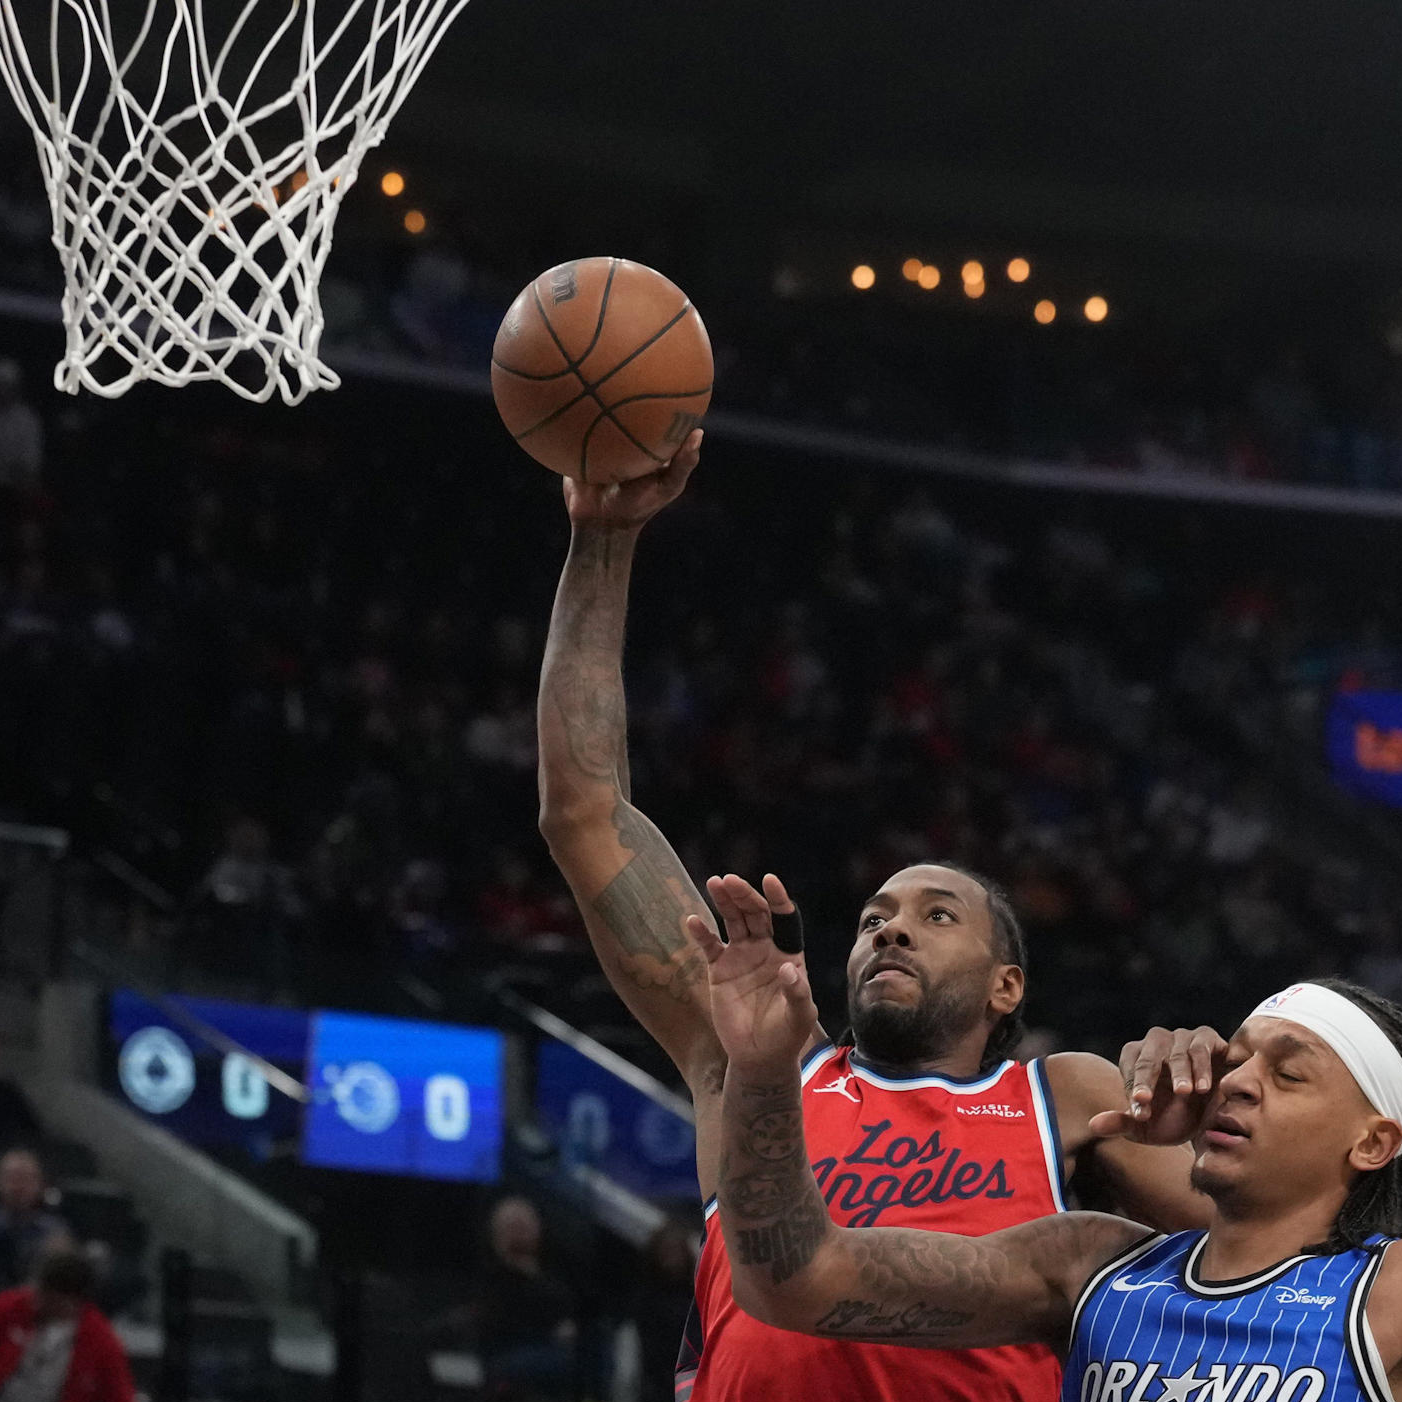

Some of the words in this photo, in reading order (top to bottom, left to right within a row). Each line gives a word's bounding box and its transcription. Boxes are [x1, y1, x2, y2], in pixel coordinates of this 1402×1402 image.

[424, 1074, 470, 1141] 0
[956, 1106, 1026, 1118] RWANDA
[844, 1119, 947, 1168] Los
[1275, 1285, 1337, 1311] Disney
